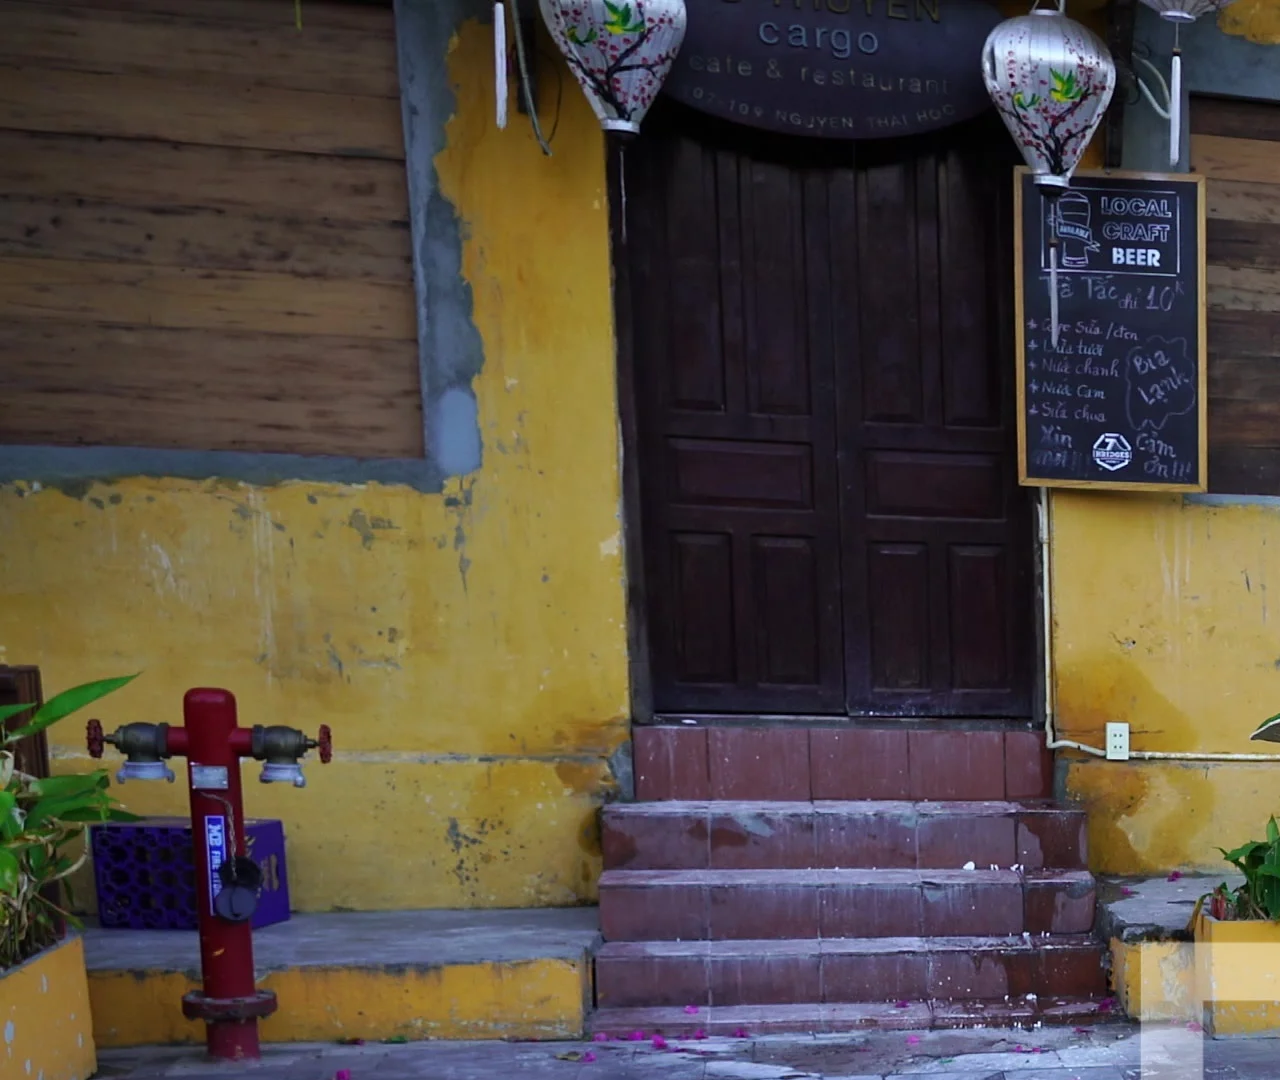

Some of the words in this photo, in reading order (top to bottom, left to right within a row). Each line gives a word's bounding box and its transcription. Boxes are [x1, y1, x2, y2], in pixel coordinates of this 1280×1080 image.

[758, 20, 879, 59] cargo
[689, 52, 754, 77] cafe
[766, 59, 783, 80] &
[801, 65, 950, 95] restaurant
[867, 114, 908, 129] THAI
[1100, 196, 1172, 218] LOCAL
[1102, 221, 1171, 243] CRAFT
[1112, 247, 1161, 268] BEER
